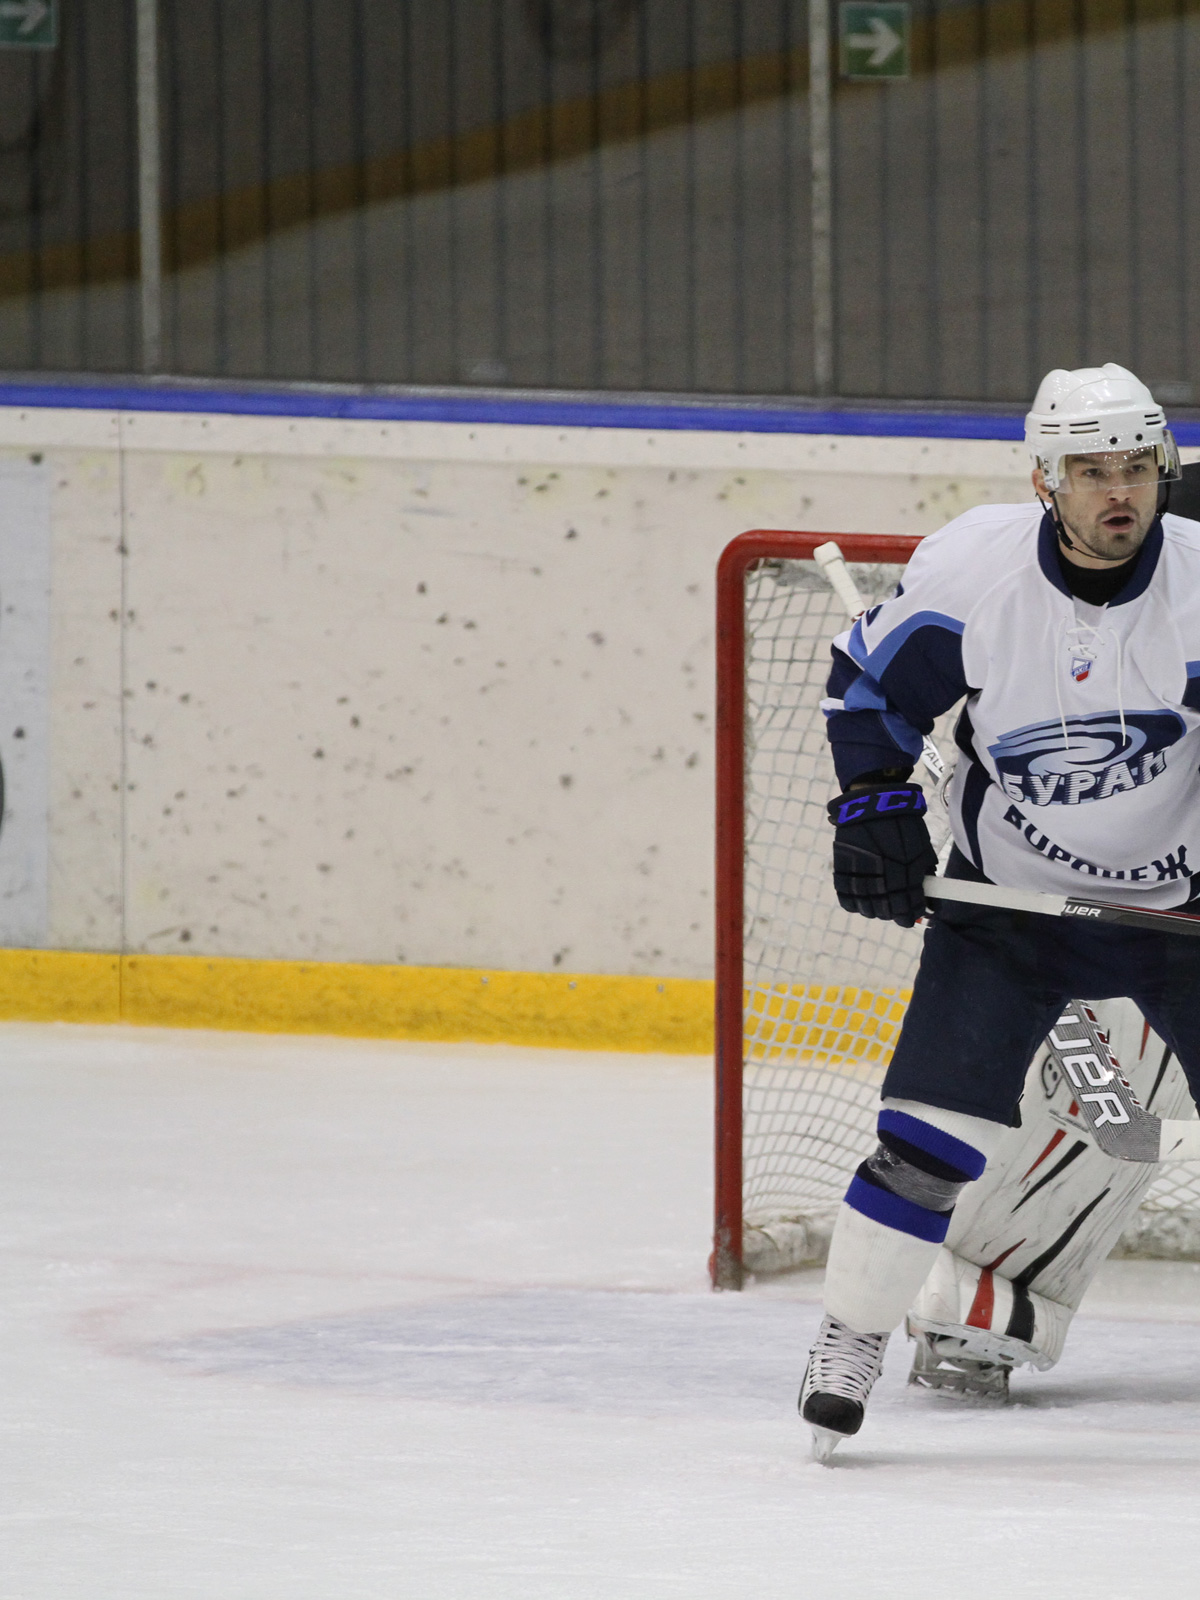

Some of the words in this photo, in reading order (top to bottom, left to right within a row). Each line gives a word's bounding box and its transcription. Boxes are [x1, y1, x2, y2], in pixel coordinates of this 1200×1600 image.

[1001, 746, 1170, 807] БУРАН
[1060, 903, 1102, 919] UER
[1049, 1002, 1131, 1129] UER
